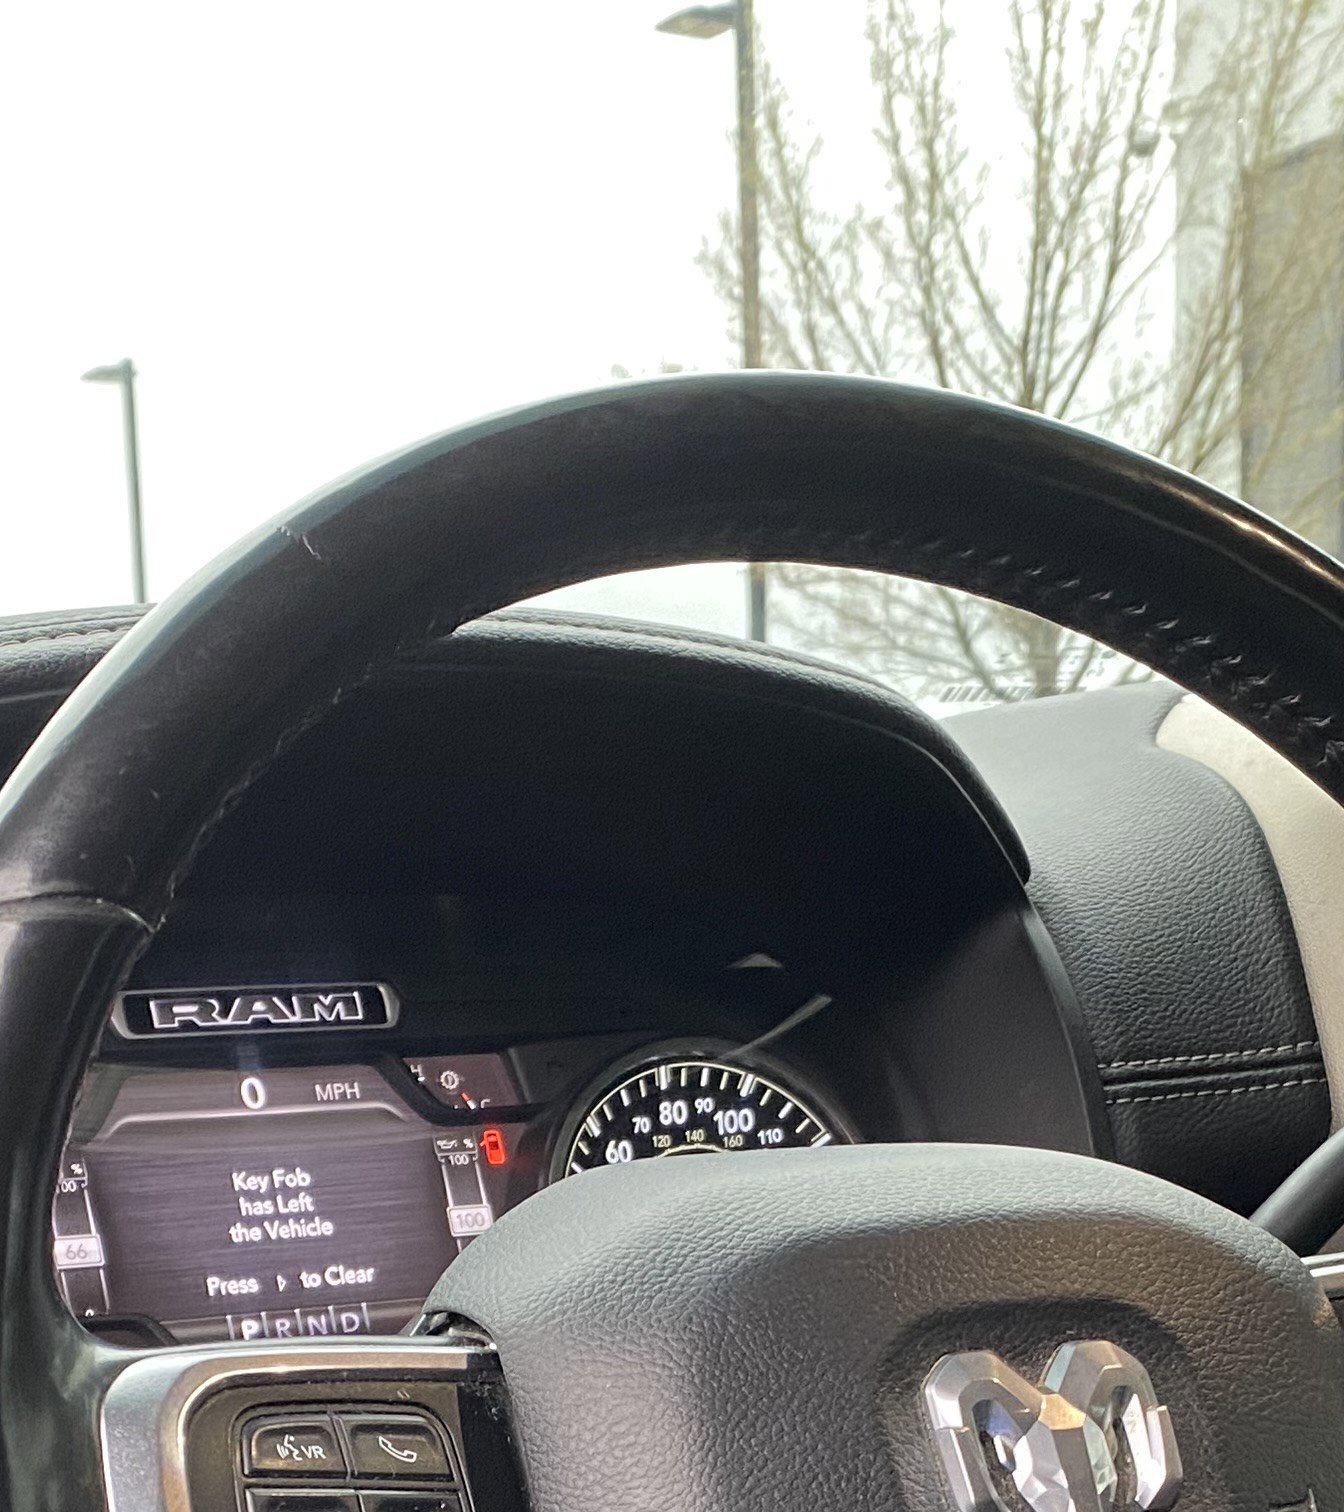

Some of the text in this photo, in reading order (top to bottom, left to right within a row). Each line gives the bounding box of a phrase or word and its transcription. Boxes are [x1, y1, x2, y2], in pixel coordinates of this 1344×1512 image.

[149, 991, 364, 1029] RAM
[240, 1076, 360, 1110] 0 MPH
[659, 1100, 688, 1126] 80
[694, 1098, 715, 1114] 90
[632, 1116, 652, 1134] 70
[713, 1108, 755, 1135] 100
[652, 1134, 672, 1148] 120
[684, 1129, 705, 1143] 140
[723, 1134, 744, 1148] 160
[757, 1128, 783, 1145] 110
[448, 1154, 470, 1166] 100
[605, 1141, 634, 1163] 60
[56, 1180, 78, 1193] 00
[231, 1167, 312, 1193] Key Fob
[239, 1192, 315, 1216] has Left
[229, 1216, 335, 1243] the Vehicle
[457, 1210, 486, 1230] 100
[65, 1243, 88, 1261] 66
[206, 1264, 375, 1297] Press to Clear
[240, 1312, 360, 1341] P R N D
[304, 1446, 327, 1460] VR
